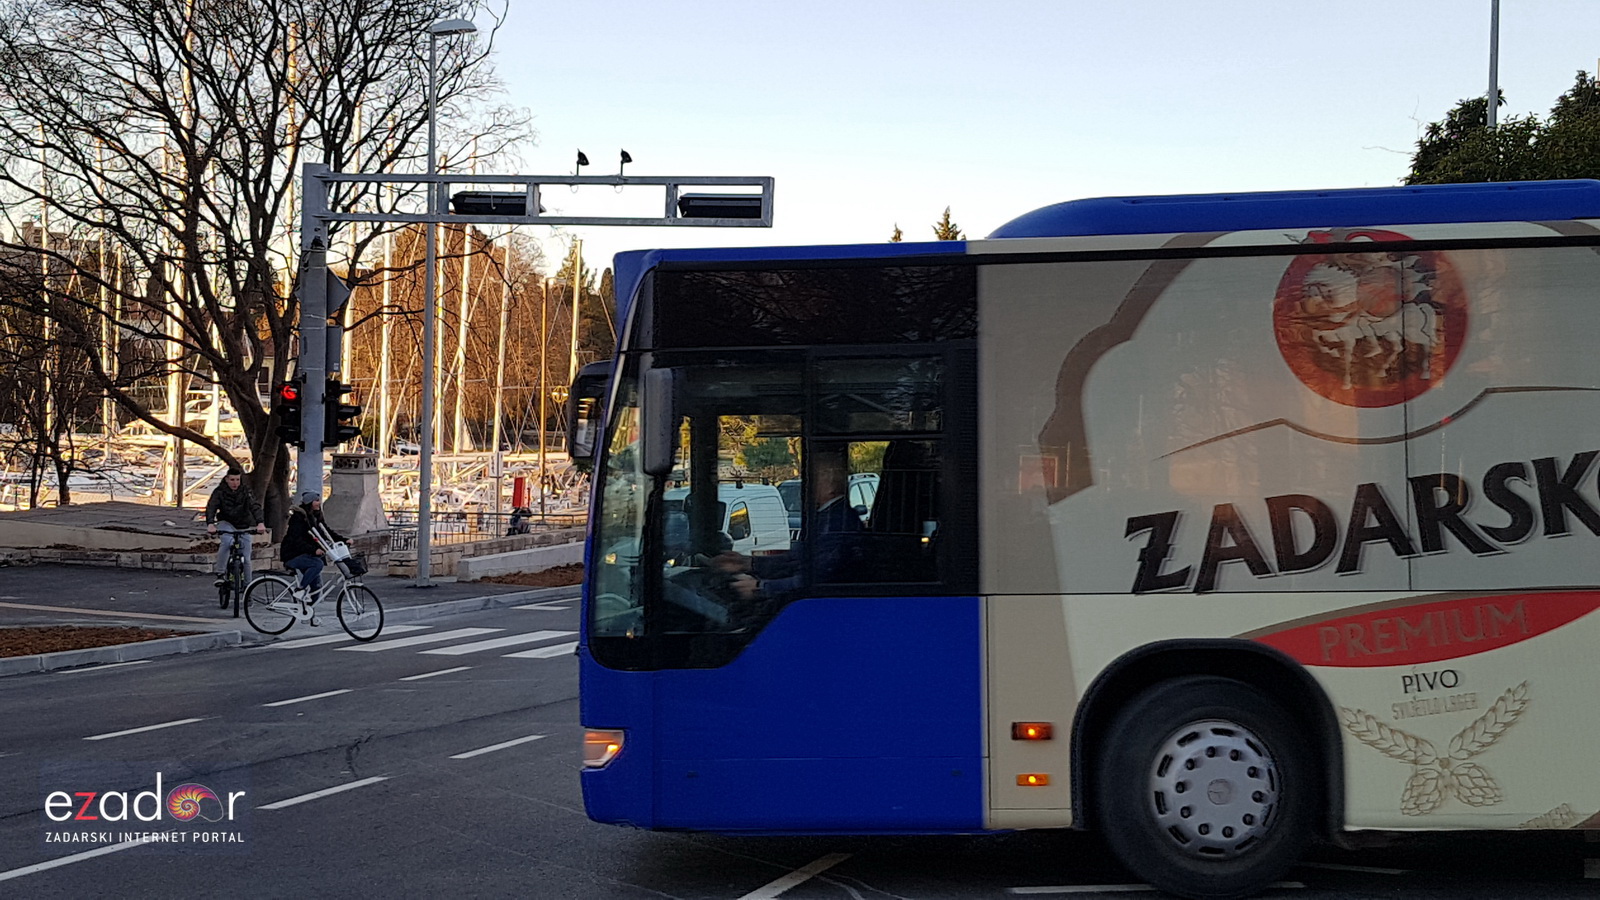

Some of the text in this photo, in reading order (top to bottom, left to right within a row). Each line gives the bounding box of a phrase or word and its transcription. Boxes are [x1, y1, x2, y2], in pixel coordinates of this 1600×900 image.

[1123, 450, 1600, 595] ZADARSK
[1317, 600, 1530, 662] PREMIUM
[1402, 669, 1459, 694] PIVO
